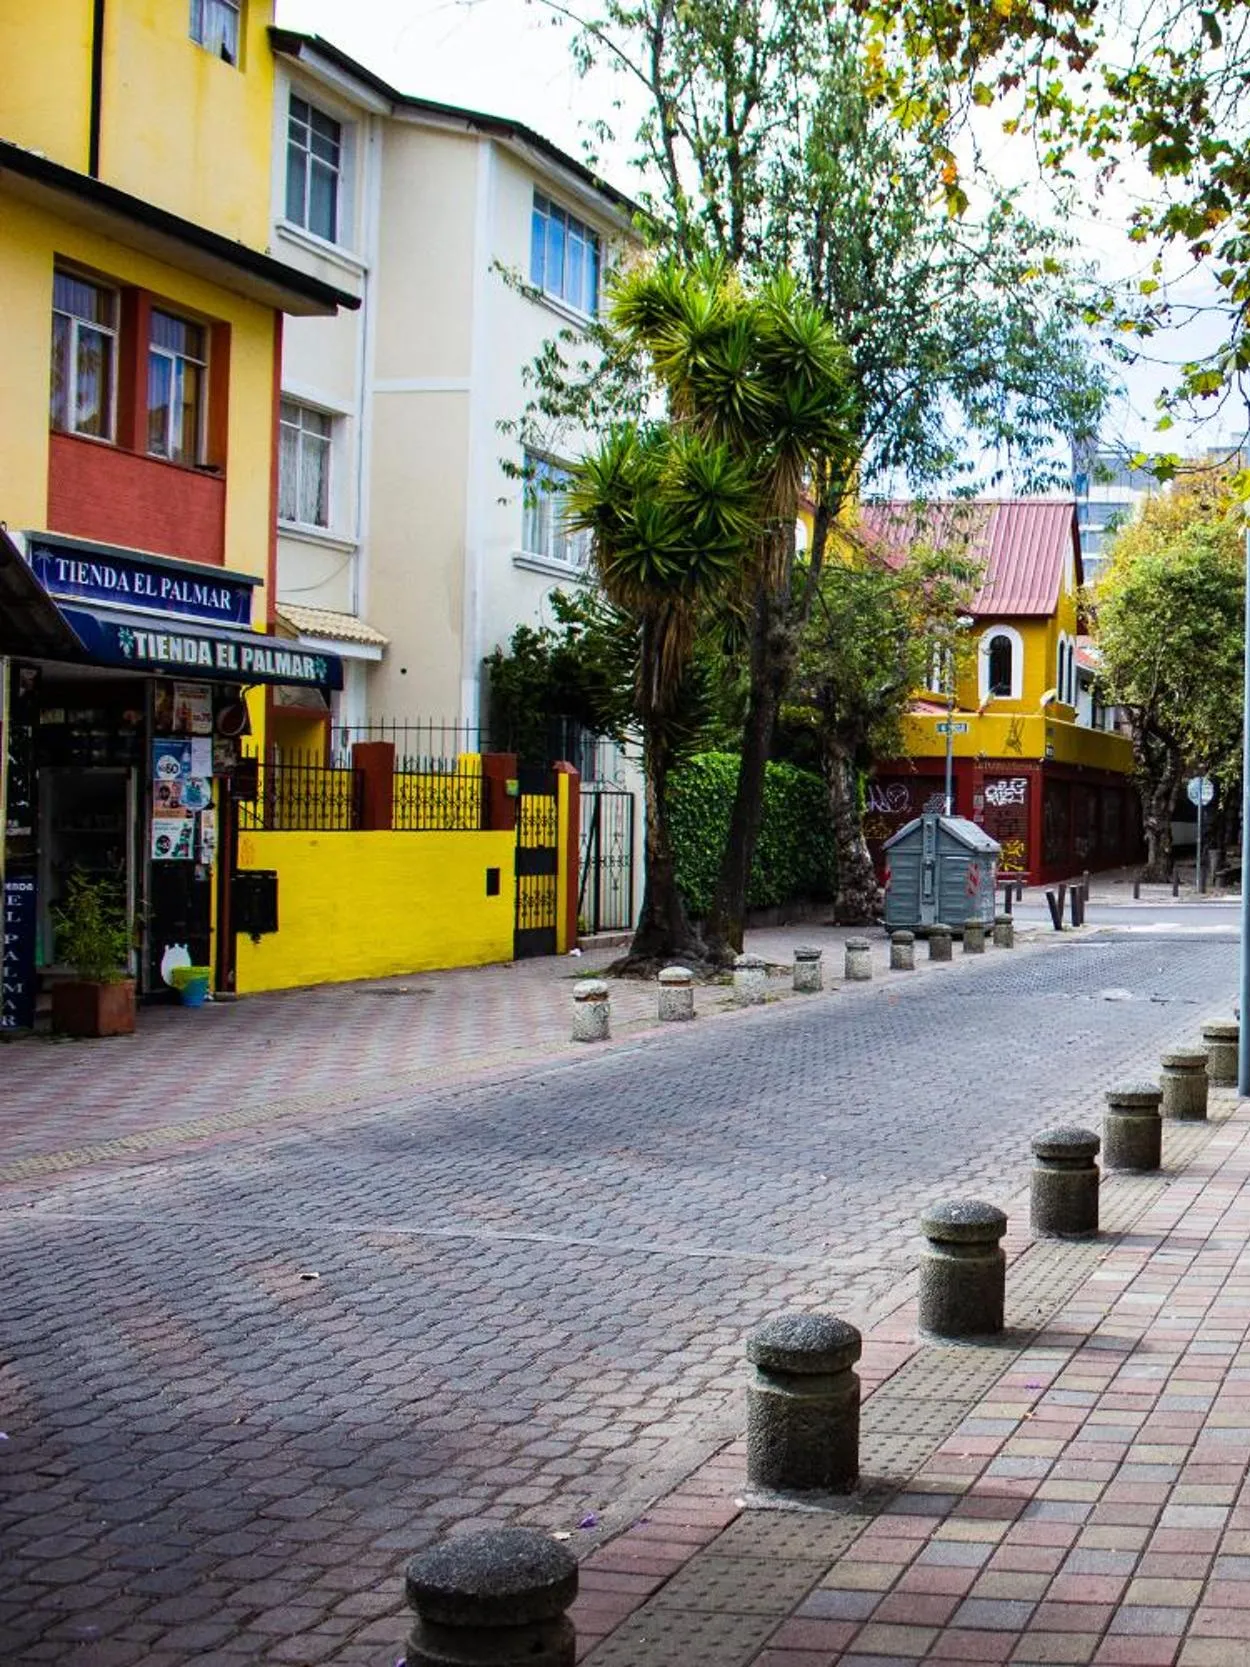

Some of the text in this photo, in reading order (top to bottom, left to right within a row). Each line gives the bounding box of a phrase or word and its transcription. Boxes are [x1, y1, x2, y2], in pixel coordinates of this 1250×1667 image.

[56, 557, 232, 611] TIENDA EL PALMAR
[133, 630, 316, 679] TIENDA EL PALMAR
